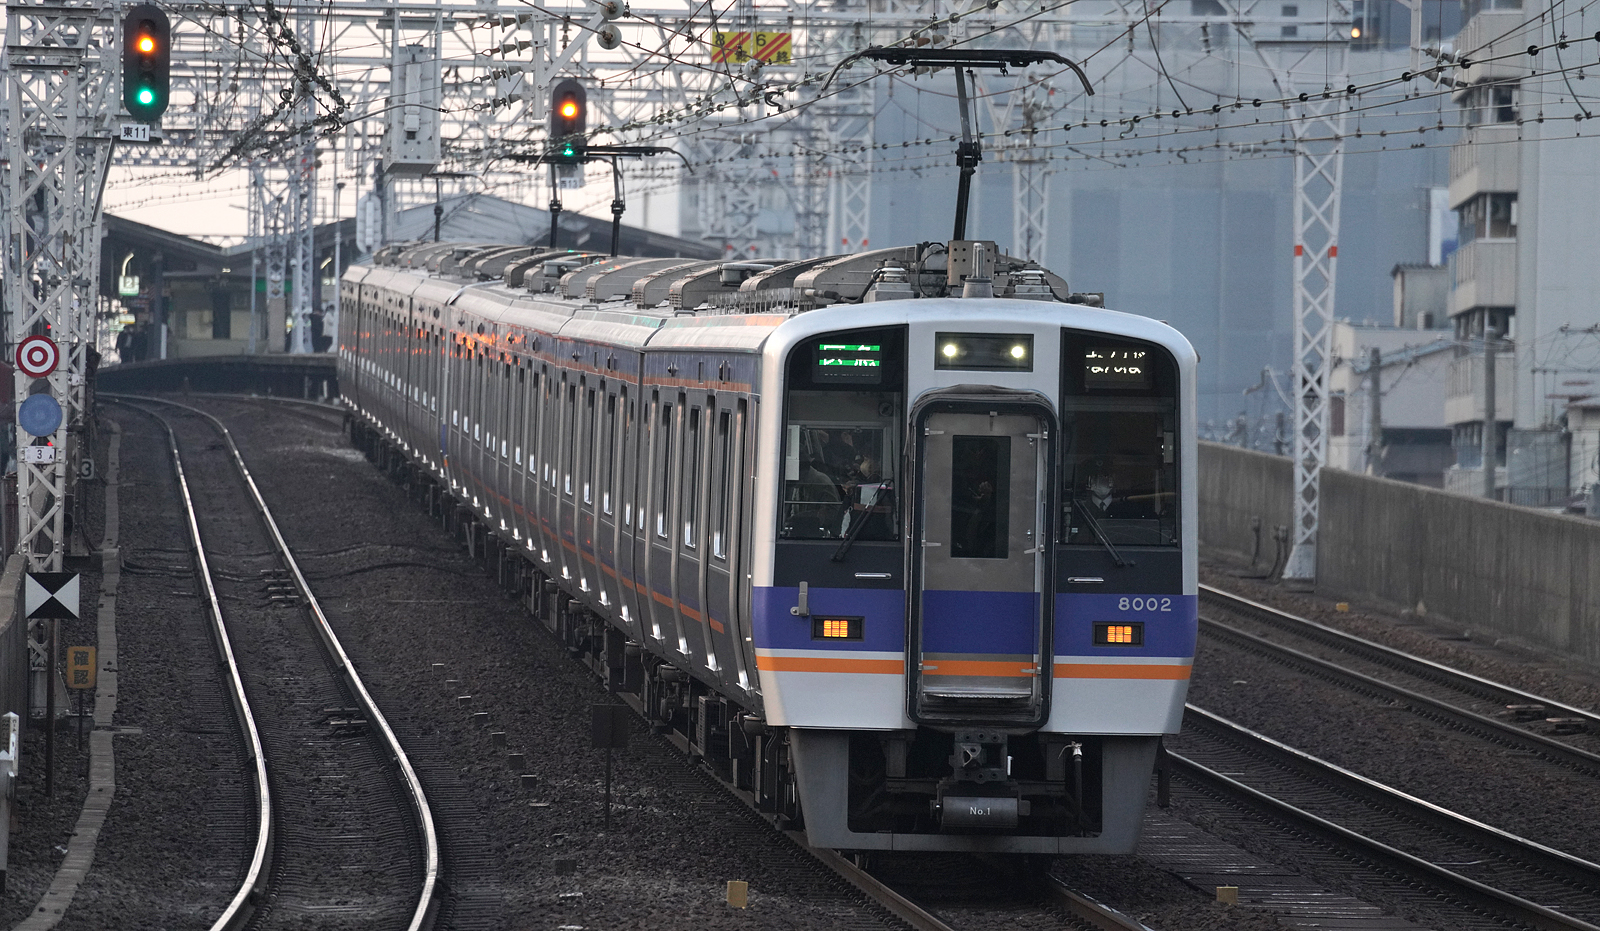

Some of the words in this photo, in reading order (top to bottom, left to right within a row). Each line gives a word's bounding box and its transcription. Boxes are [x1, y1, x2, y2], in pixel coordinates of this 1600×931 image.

[715, 33, 725, 46] 8
[756, 33, 767, 47] 6
[123, 126, 146, 139] 東11
[125, 277, 133, 288] 2
[37, 449, 43, 460] 3
[81, 461, 92, 477] 3
[1118, 597, 1172, 612] 8002
[969, 806, 990, 816] No.1
